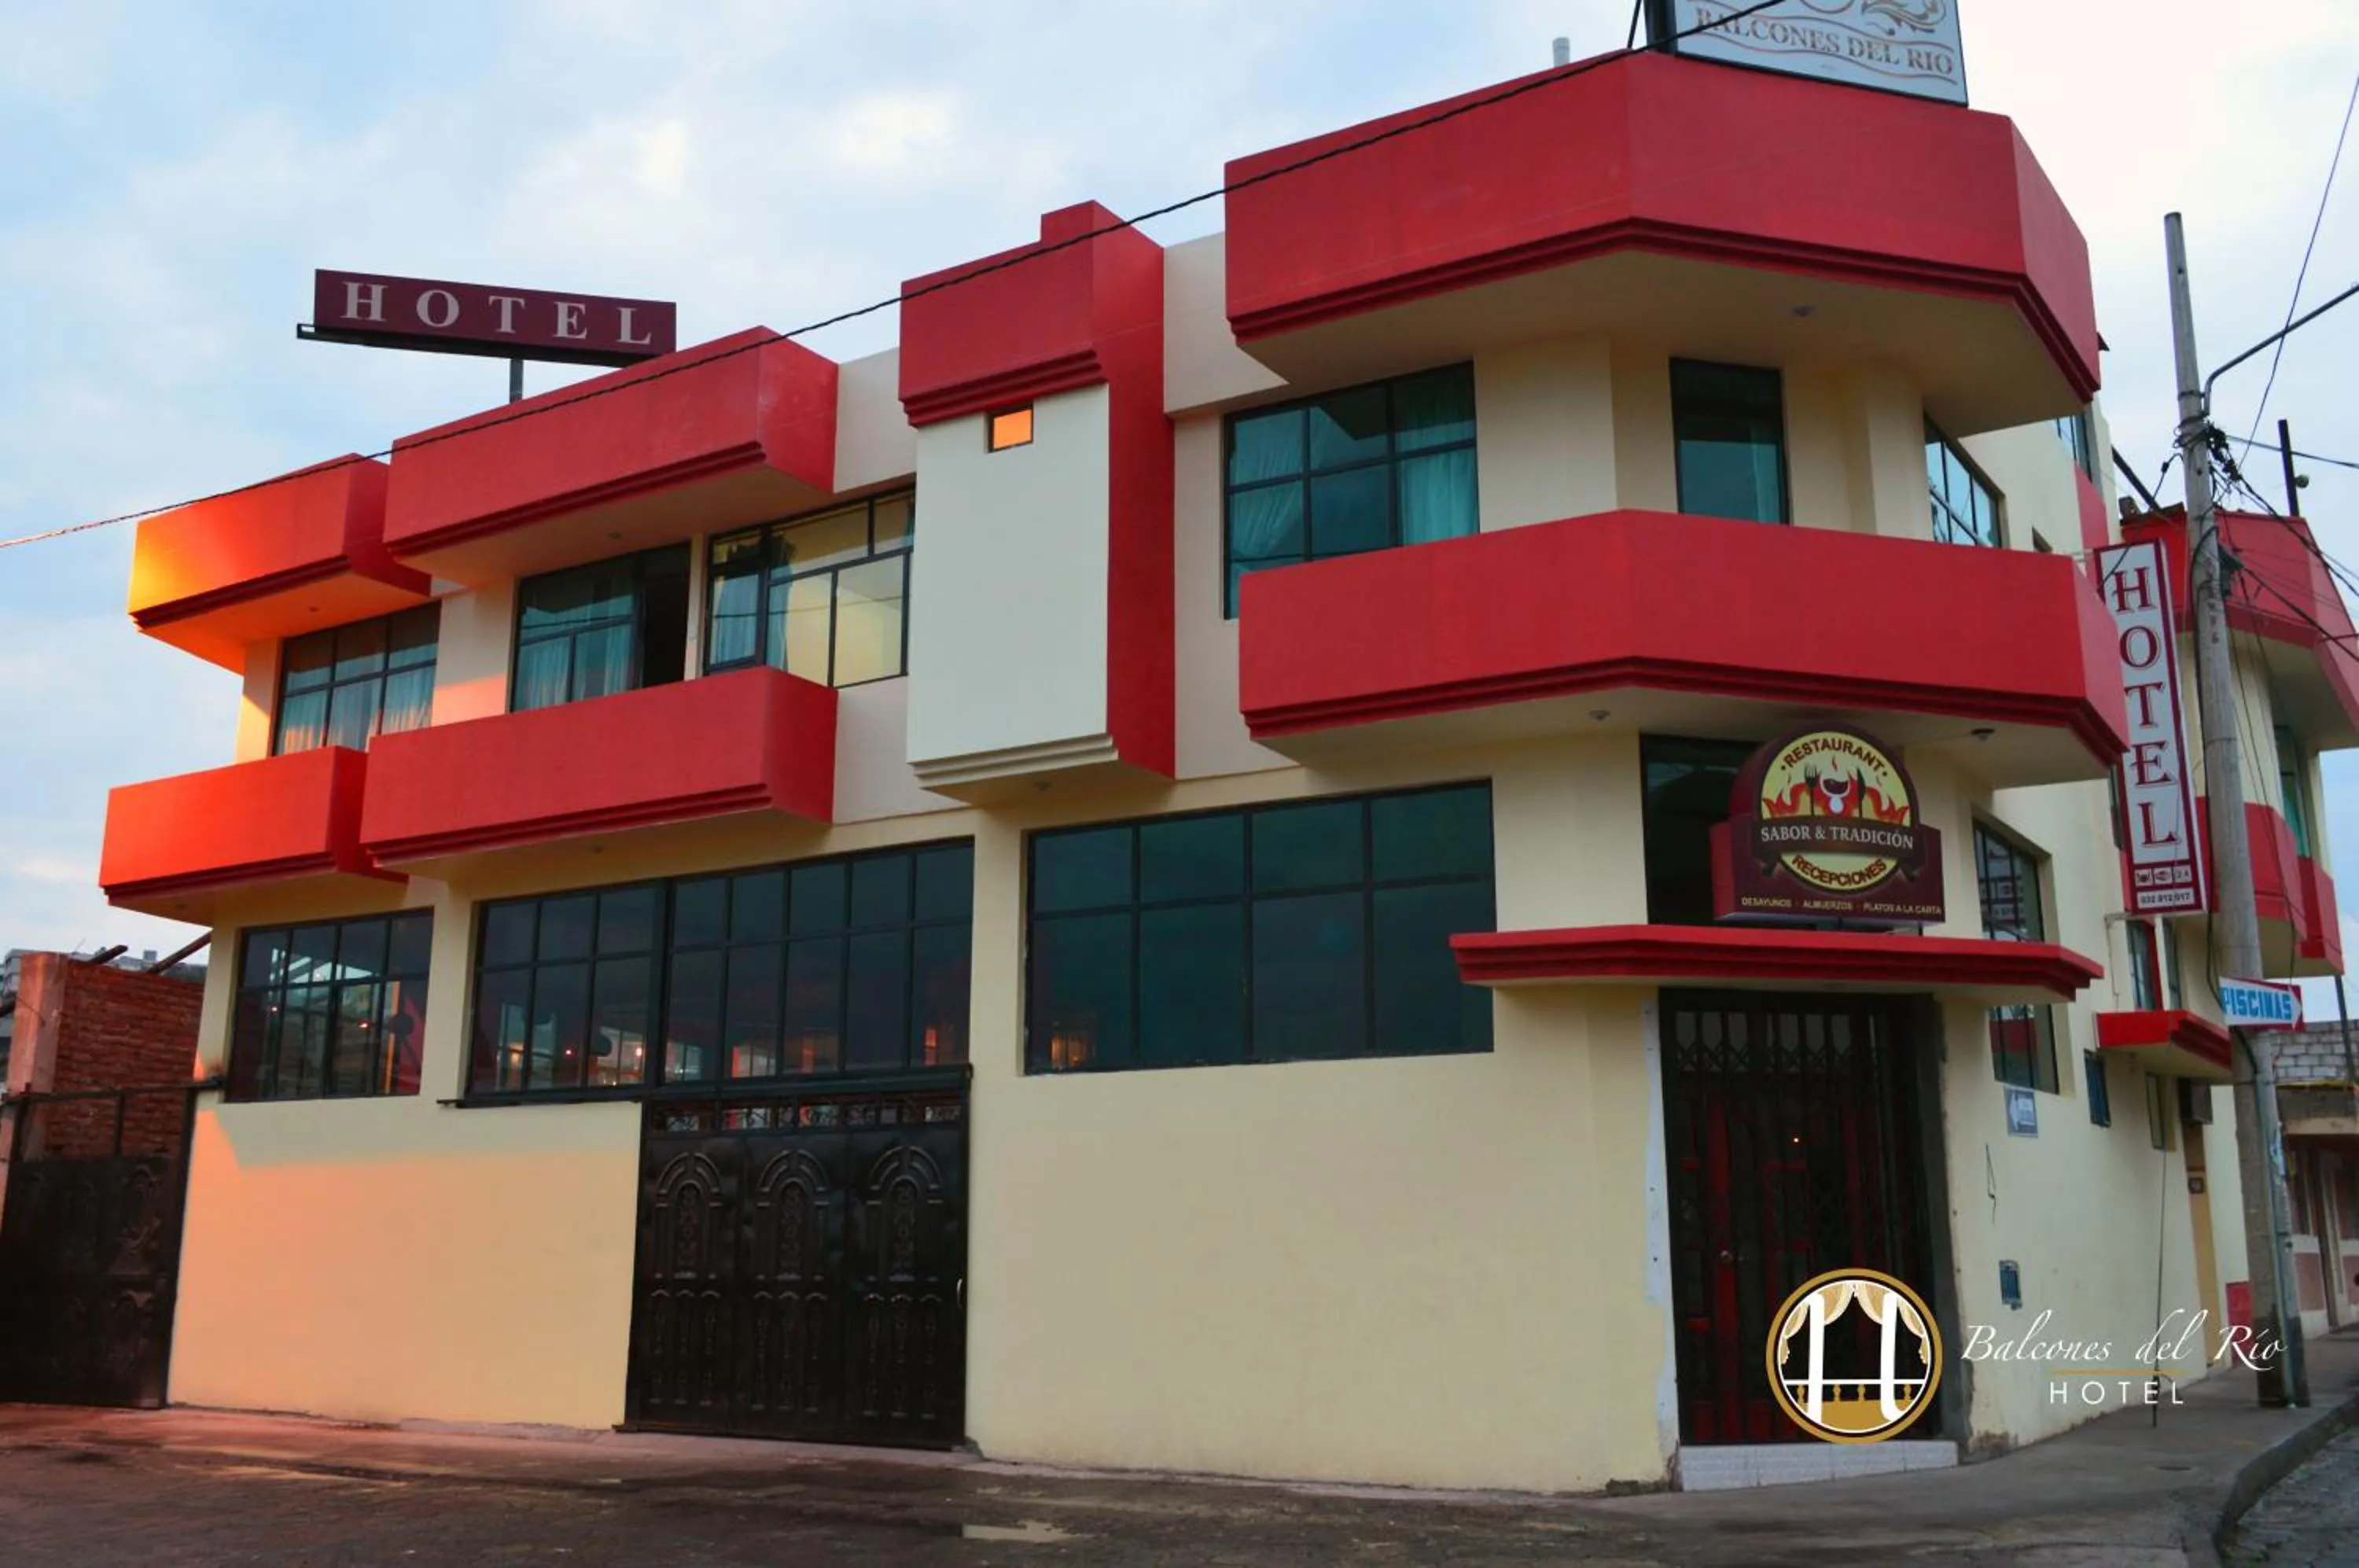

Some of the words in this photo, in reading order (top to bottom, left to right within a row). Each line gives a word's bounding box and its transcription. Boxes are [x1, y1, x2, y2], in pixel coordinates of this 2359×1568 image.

[1695, 7, 1841, 54] BALCONES
[1848, 36, 1900, 65] DEL
[1908, 50, 1954, 75] RIO
[340, 281, 652, 345] HOTEL
[2112, 565, 2181, 847] HOTEL
[1784, 738, 1885, 773] RESTAURANT
[1761, 825, 1811, 842] SABOR
[1815, 827, 1826, 840] &
[1829, 826, 1914, 849] TRADICIÓN
[1791, 854, 1887, 886] RECEPCIONES
[2221, 986, 2292, 1021] PISCINAS
